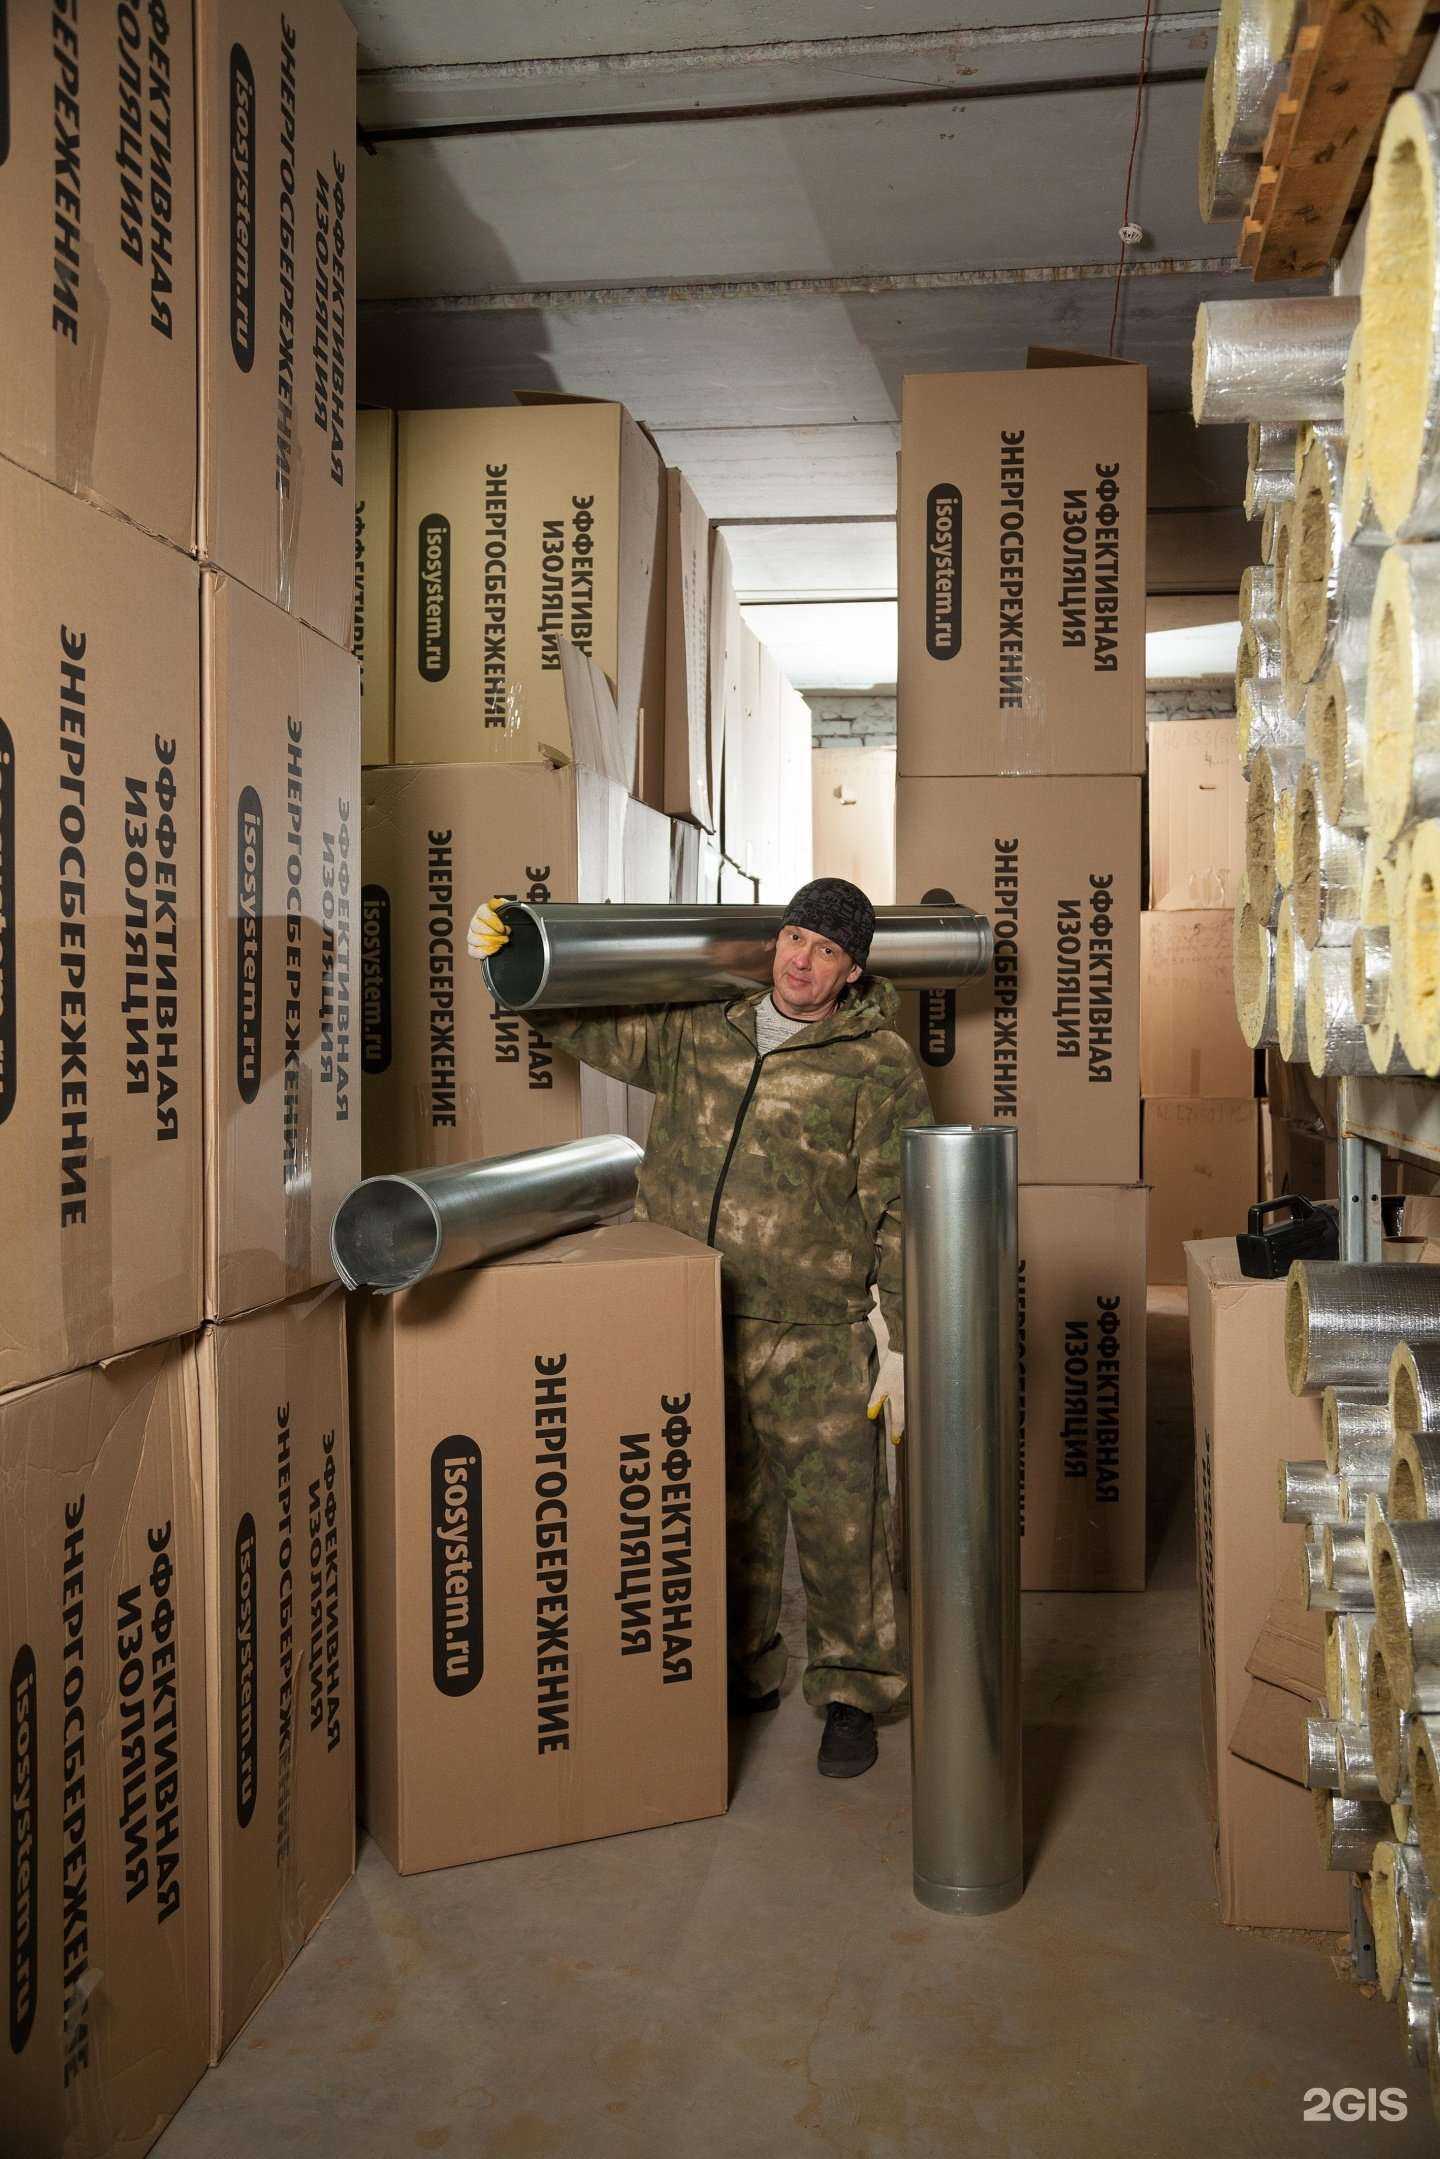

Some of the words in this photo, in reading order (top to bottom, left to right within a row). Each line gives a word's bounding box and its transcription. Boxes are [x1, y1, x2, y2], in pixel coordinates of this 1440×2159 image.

[116, 0, 143, 266] ОЛЯЦИЯ
[233, 70, 251, 348] isosystem.ru
[276, 13, 297, 500] ЭНЕРГОСБЕРЕЖЕНИЕ
[312, 168, 328, 431] ИЗОЛЯЦИЯ
[330, 150, 346, 487] ЭФФЕКТИВНАЯ
[420, 527, 448, 670] isosystem.ru
[484, 463, 508, 729] ЭНЕРГОСБЕРЕЖЕНИЕ
[537, 520, 564, 670] ИЗОЛЯЦИЯ
[930, 496, 959, 647] isosystem.ru
[999, 430, 1025, 709] ЭНЕРГОСБЕРЕЖЕНИЕ
[1058, 489, 1087, 647] ИЗОЛЯЦИЯ
[1094, 462, 1120, 672] ЭФФЕКТИВНАЯ
[60, 623, 88, 1228] ЭНЕРГОСБЕРЕЖЕНИЕ
[121, 777, 149, 1094] ИЗОЛЯЦИЯ
[155, 733, 179, 1141] ЭФФЕКТИВНАЯ
[240, 811, 262, 1079] isosystem.ru
[318, 830, 335, 1084] ИЗОЛЯЦИЯ
[336, 796, 350, 1121] ЭФФЕКТИВНАЯ
[362, 900, 389, 1060] isosystem.ru
[428, 829, 456, 1127] ЭНЕРГОСБЕРЕЖЕНИЕ
[993, 838, 1019, 1117] ЭНЕРГОСБЕРЕЖЕНИЕ
[1052, 900, 1081, 1057] ИЗОЛЯЦИЯ
[1088, 873, 1114, 1082] ЭФФЕКТИВНАЯ
[1060, 1320, 1089, 1478] ИЗОЛЯЦИЯ
[1096, 1295, 1120, 1503] ЭФФЕКТИВНАЯ
[238, 1535, 256, 1806] isosystem.ru
[308, 1478, 324, 1733] ИЗОЛЯЦИЯ
[322, 1428, 341, 1754] ЭФФЕКТИВНАЯ
[437, 1456, 476, 1678] isosystem.ru
[534, 1353, 570, 1755] ЭНЕРГОСБЕРЕЖЕНИЕ
[614, 1433, 652, 1656] ИЗОЛЯЦИЯ
[660, 1392, 693, 1684] ЭФФЕКТИВНАЯ
[13, 1672, 34, 2024] isosystem.ru
[118, 1585, 149, 1904] ИЗОЛЯЦИЯ
[148, 1519, 181, 1925] ЭФФЕКТИВНАЯ
